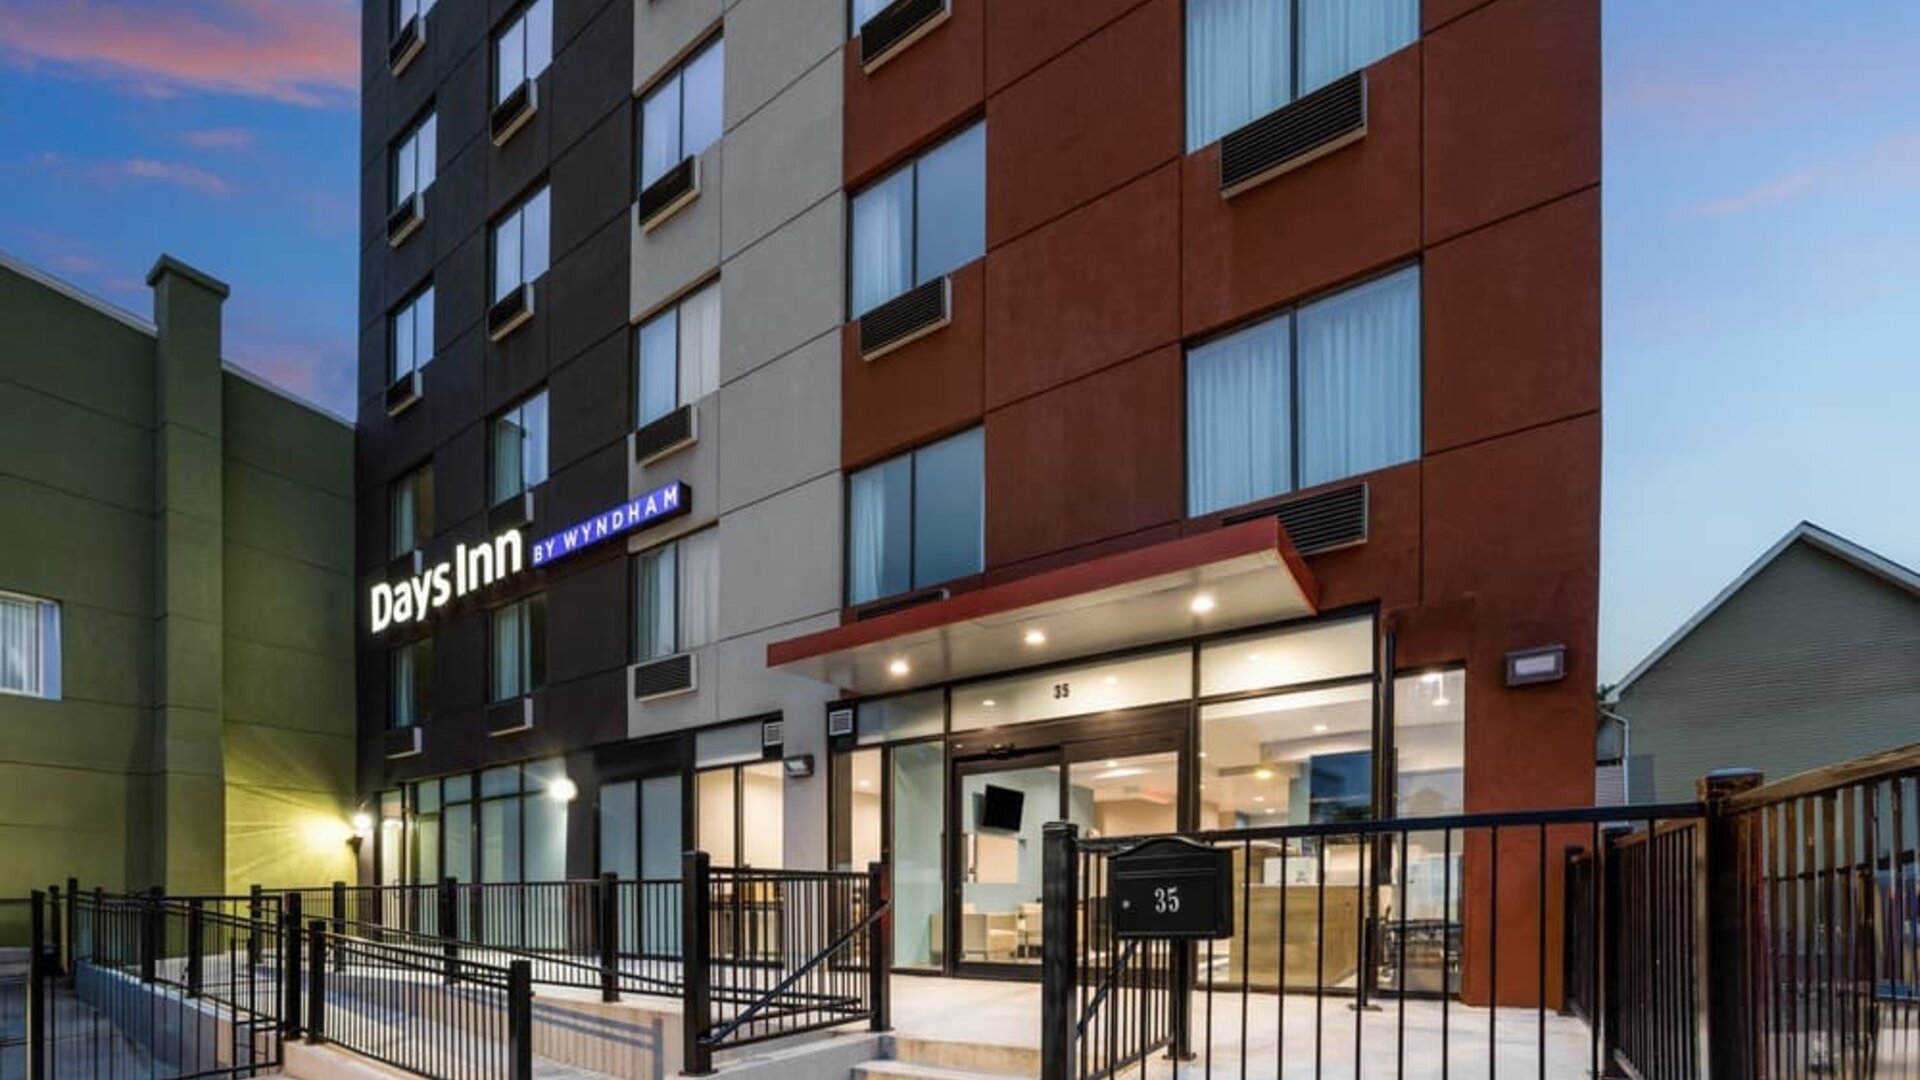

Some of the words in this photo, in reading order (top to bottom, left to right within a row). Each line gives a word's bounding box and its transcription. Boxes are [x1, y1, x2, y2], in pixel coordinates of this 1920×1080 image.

[370, 561, 451, 634] Days
[456, 528, 522, 598] Inn
[532, 537, 555, 567] BY
[563, 484, 678, 551] WYNDHAM
[1053, 683, 1070, 699] 35
[1154, 886, 1180, 914] 35
